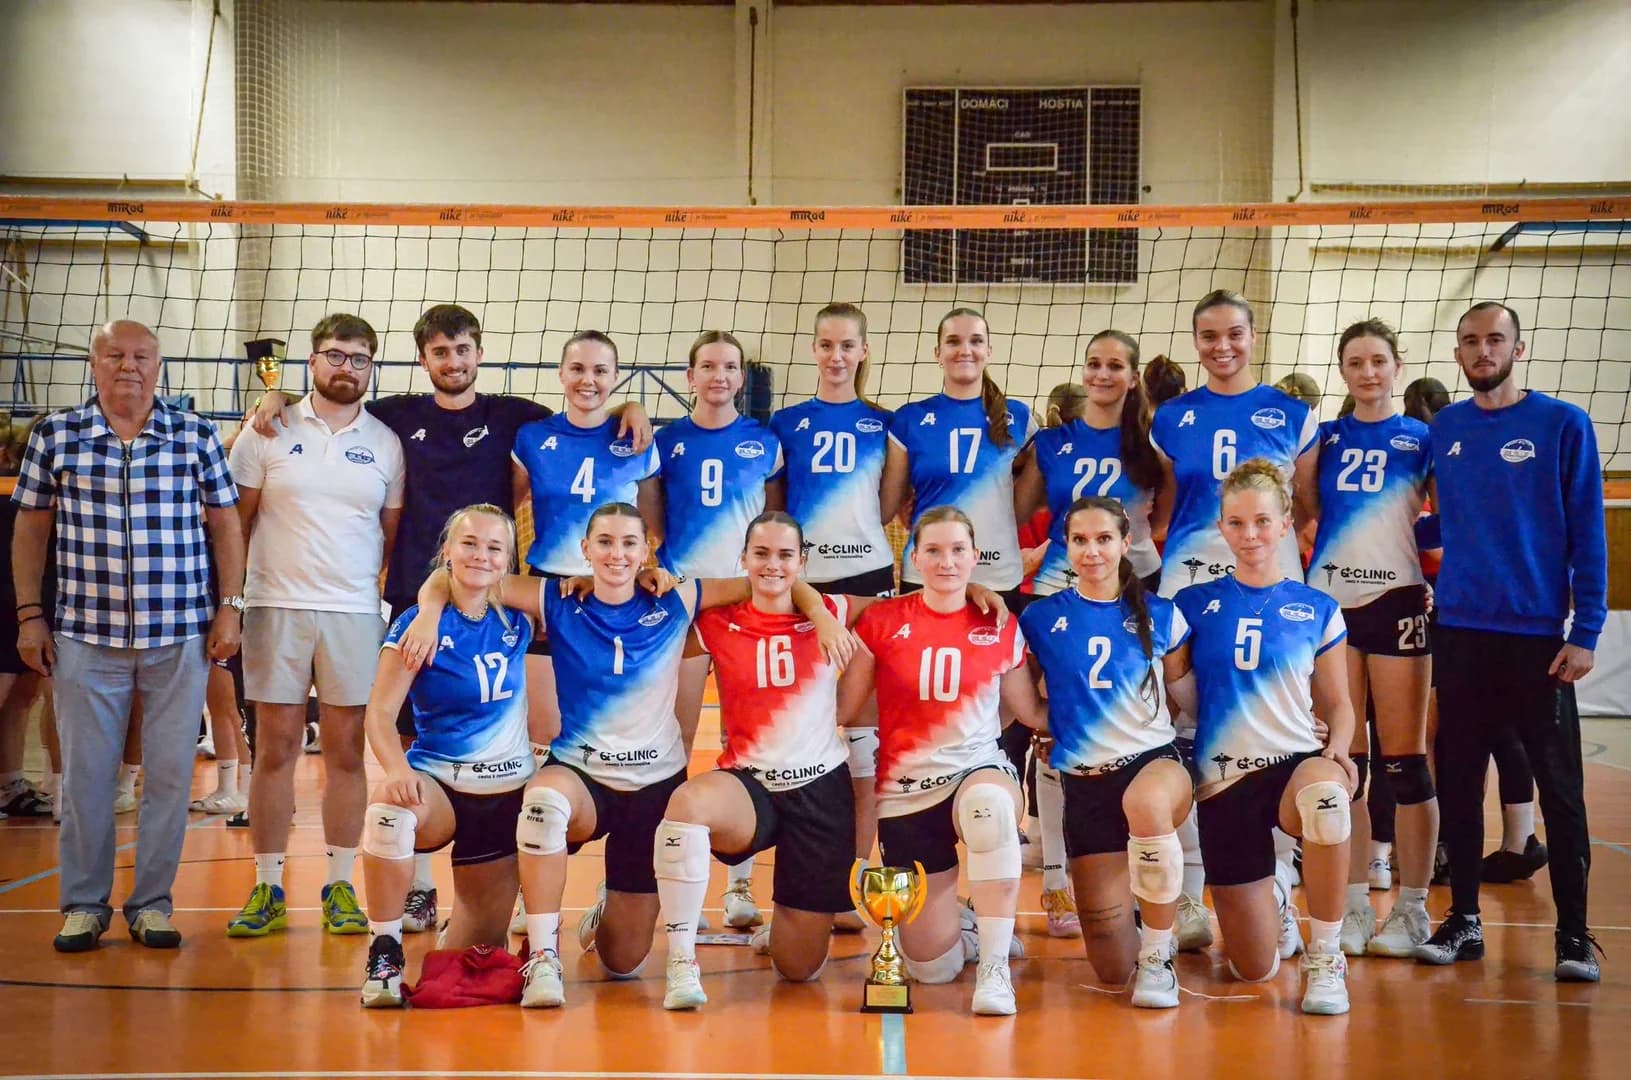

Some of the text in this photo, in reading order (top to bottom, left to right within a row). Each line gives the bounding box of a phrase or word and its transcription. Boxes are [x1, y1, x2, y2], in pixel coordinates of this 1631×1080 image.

[811, 431, 856, 473] 20
[950, 428, 982, 474] 17
[1213, 429, 1236, 481] 6
[1337, 449, 1387, 492] 23
[570, 457, 596, 503] 4
[701, 459, 723, 507] 9
[1072, 458, 1121, 503] 22
[613, 636, 624, 674] 1
[1235, 618, 1263, 670] 5
[1398, 617, 1428, 650] 23
[473, 652, 513, 703] 12
[756, 635, 795, 688] 16
[919, 647, 961, 701] 10
[1087, 636, 1113, 689] 2
